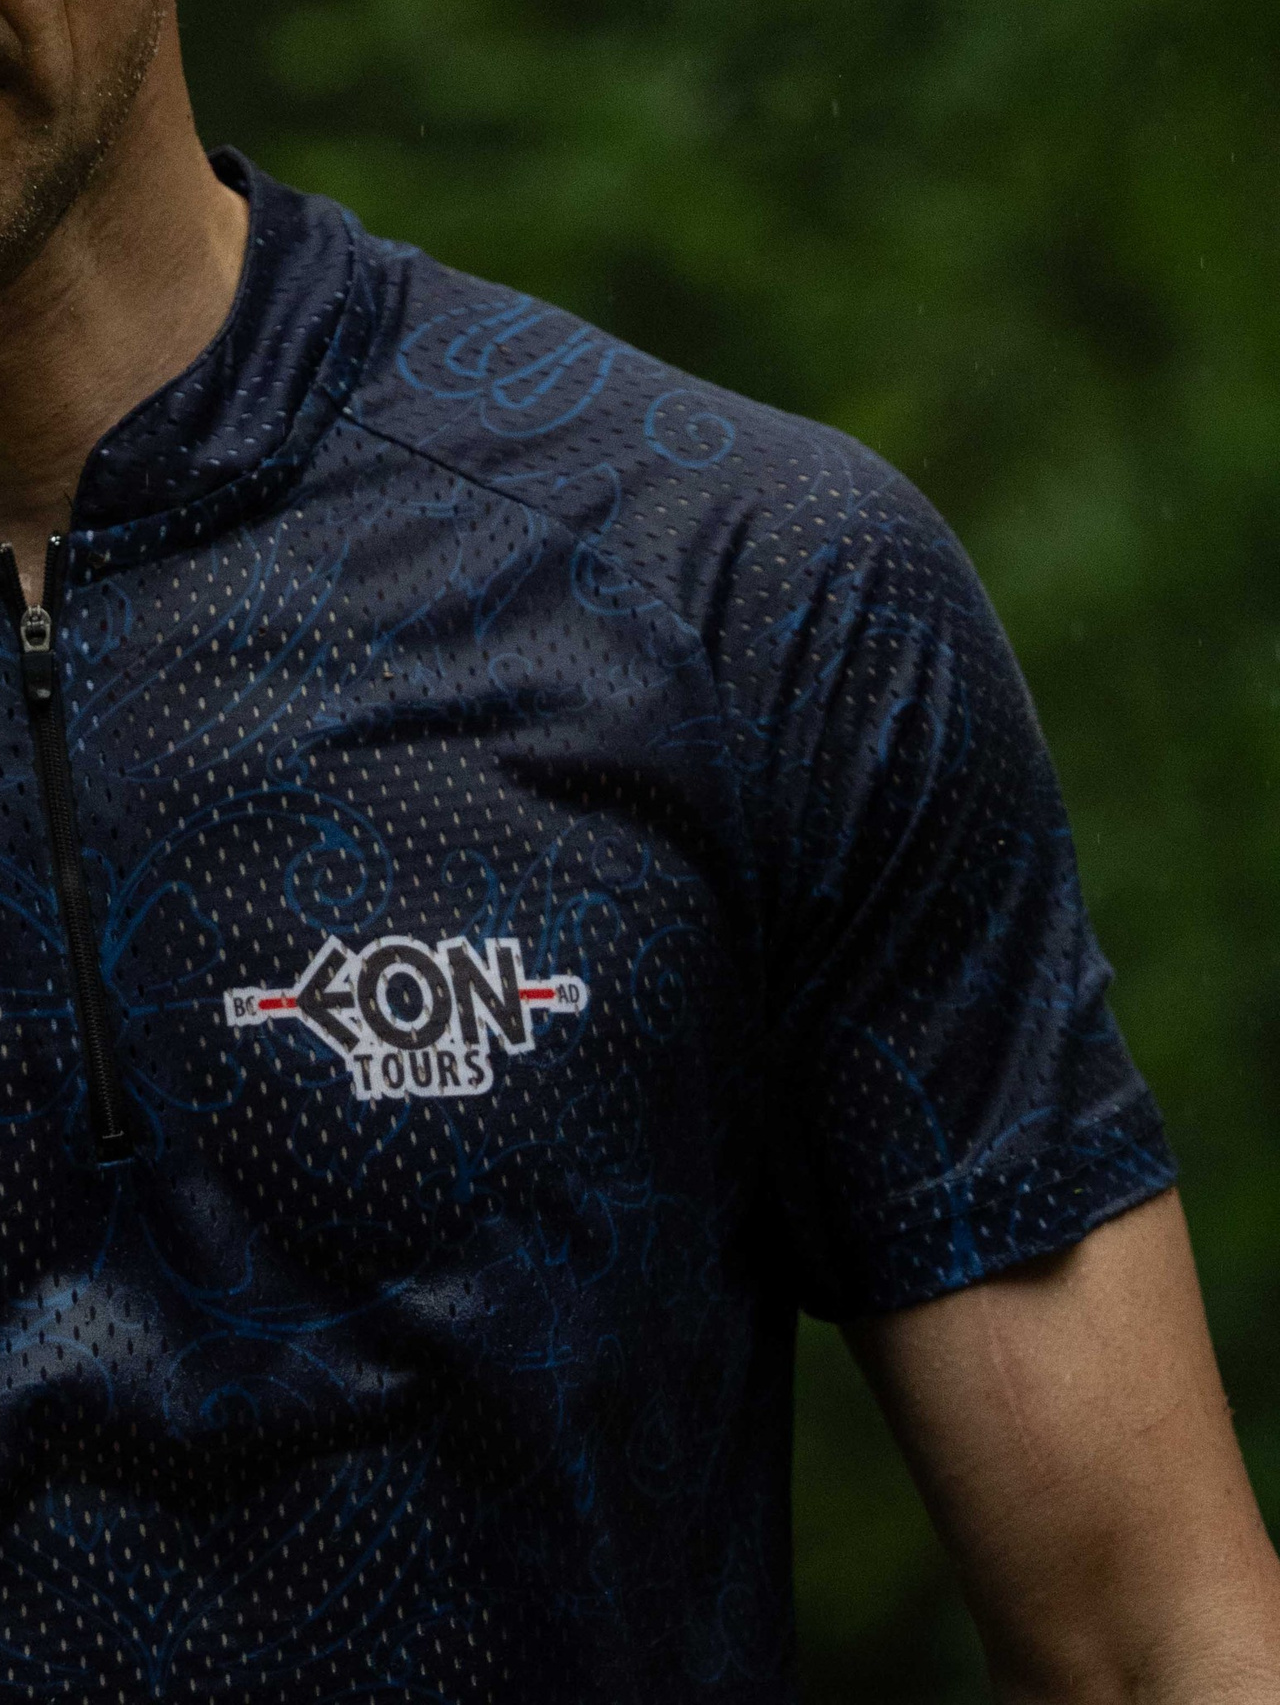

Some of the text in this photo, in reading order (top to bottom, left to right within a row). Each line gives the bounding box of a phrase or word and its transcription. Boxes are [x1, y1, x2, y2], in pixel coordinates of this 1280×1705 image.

[233, 994, 258, 1018] BC
[555, 982, 581, 1005] AD
[352, 1049, 489, 1093] TOURS
